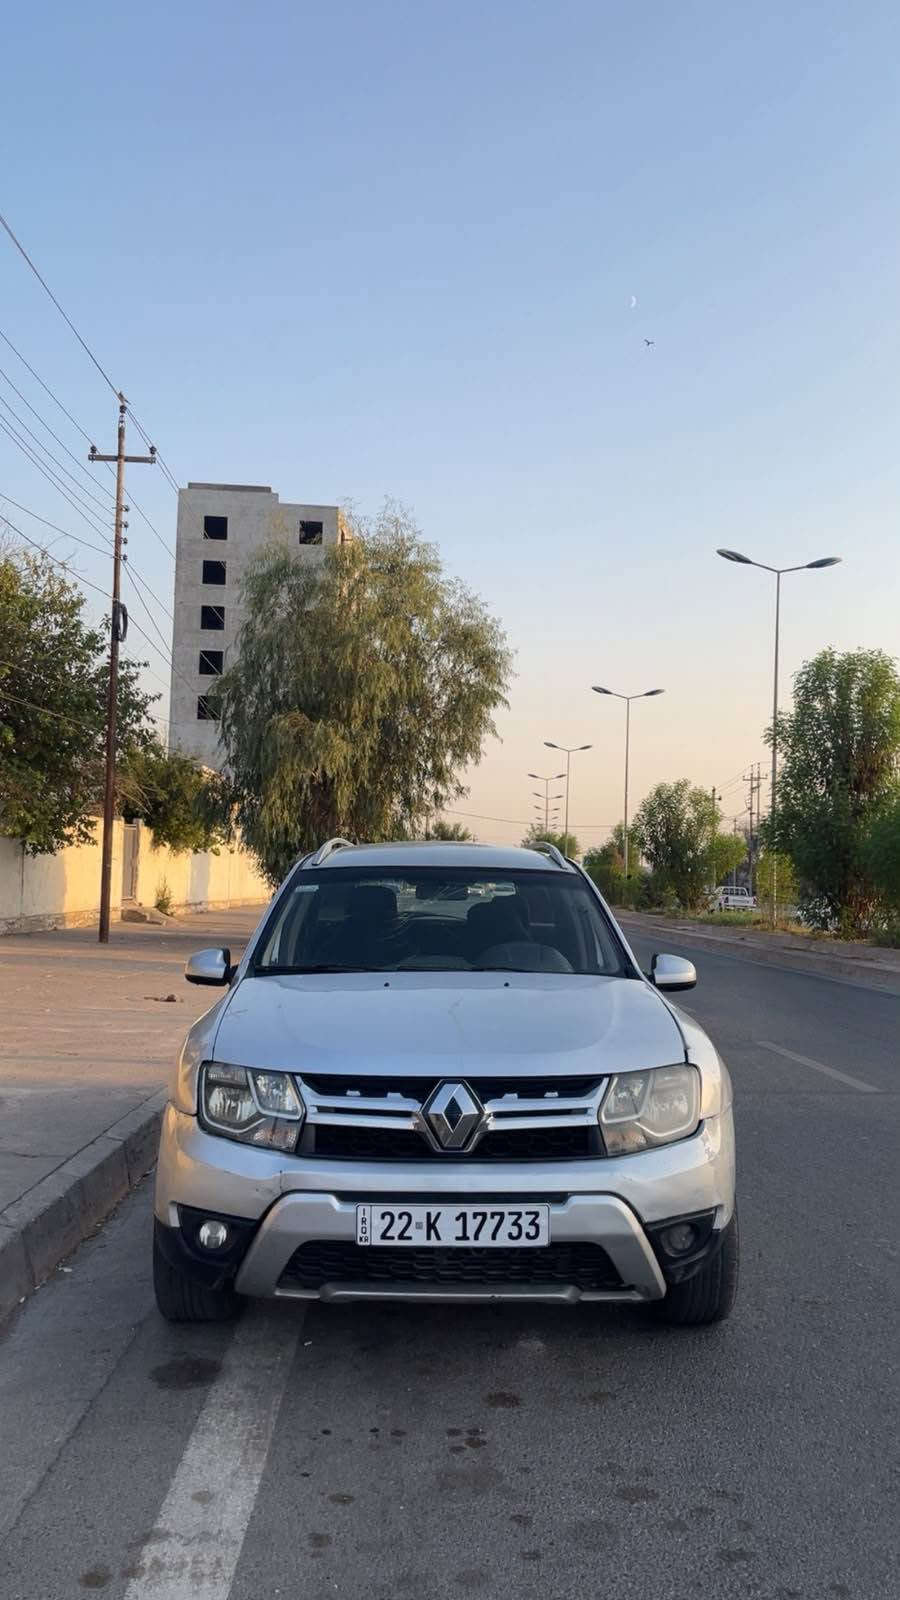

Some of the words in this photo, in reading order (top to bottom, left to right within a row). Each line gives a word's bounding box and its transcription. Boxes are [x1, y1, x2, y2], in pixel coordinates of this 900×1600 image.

[380, 1211, 413, 1241] 22
[426, 1211, 442, 1241] K
[455, 1211, 541, 1241] 17733
